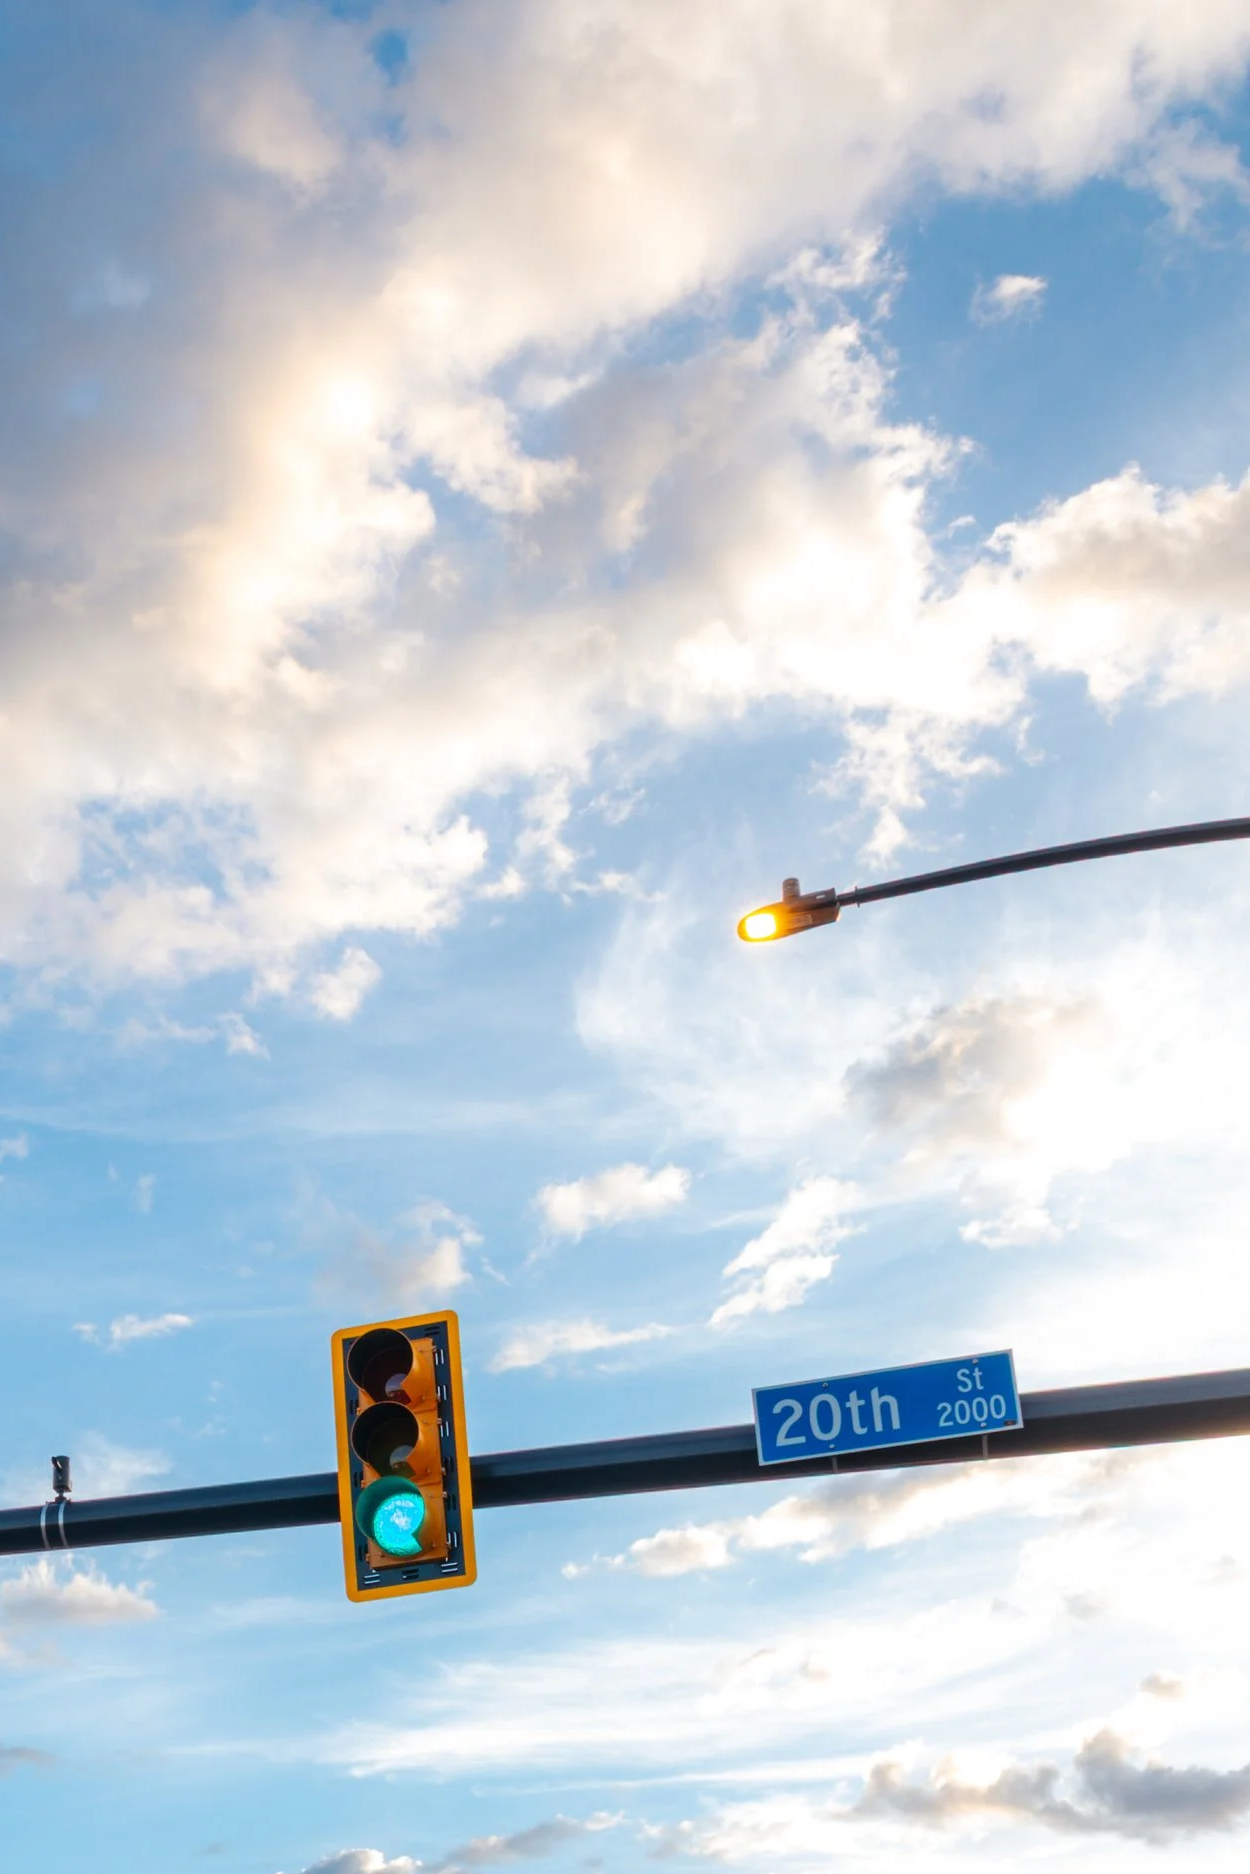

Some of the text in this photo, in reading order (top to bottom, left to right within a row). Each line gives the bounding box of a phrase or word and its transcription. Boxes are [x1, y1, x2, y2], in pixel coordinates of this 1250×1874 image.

[957, 1367, 984, 1393] St
[772, 1387, 1006, 1447] 20th 2000
